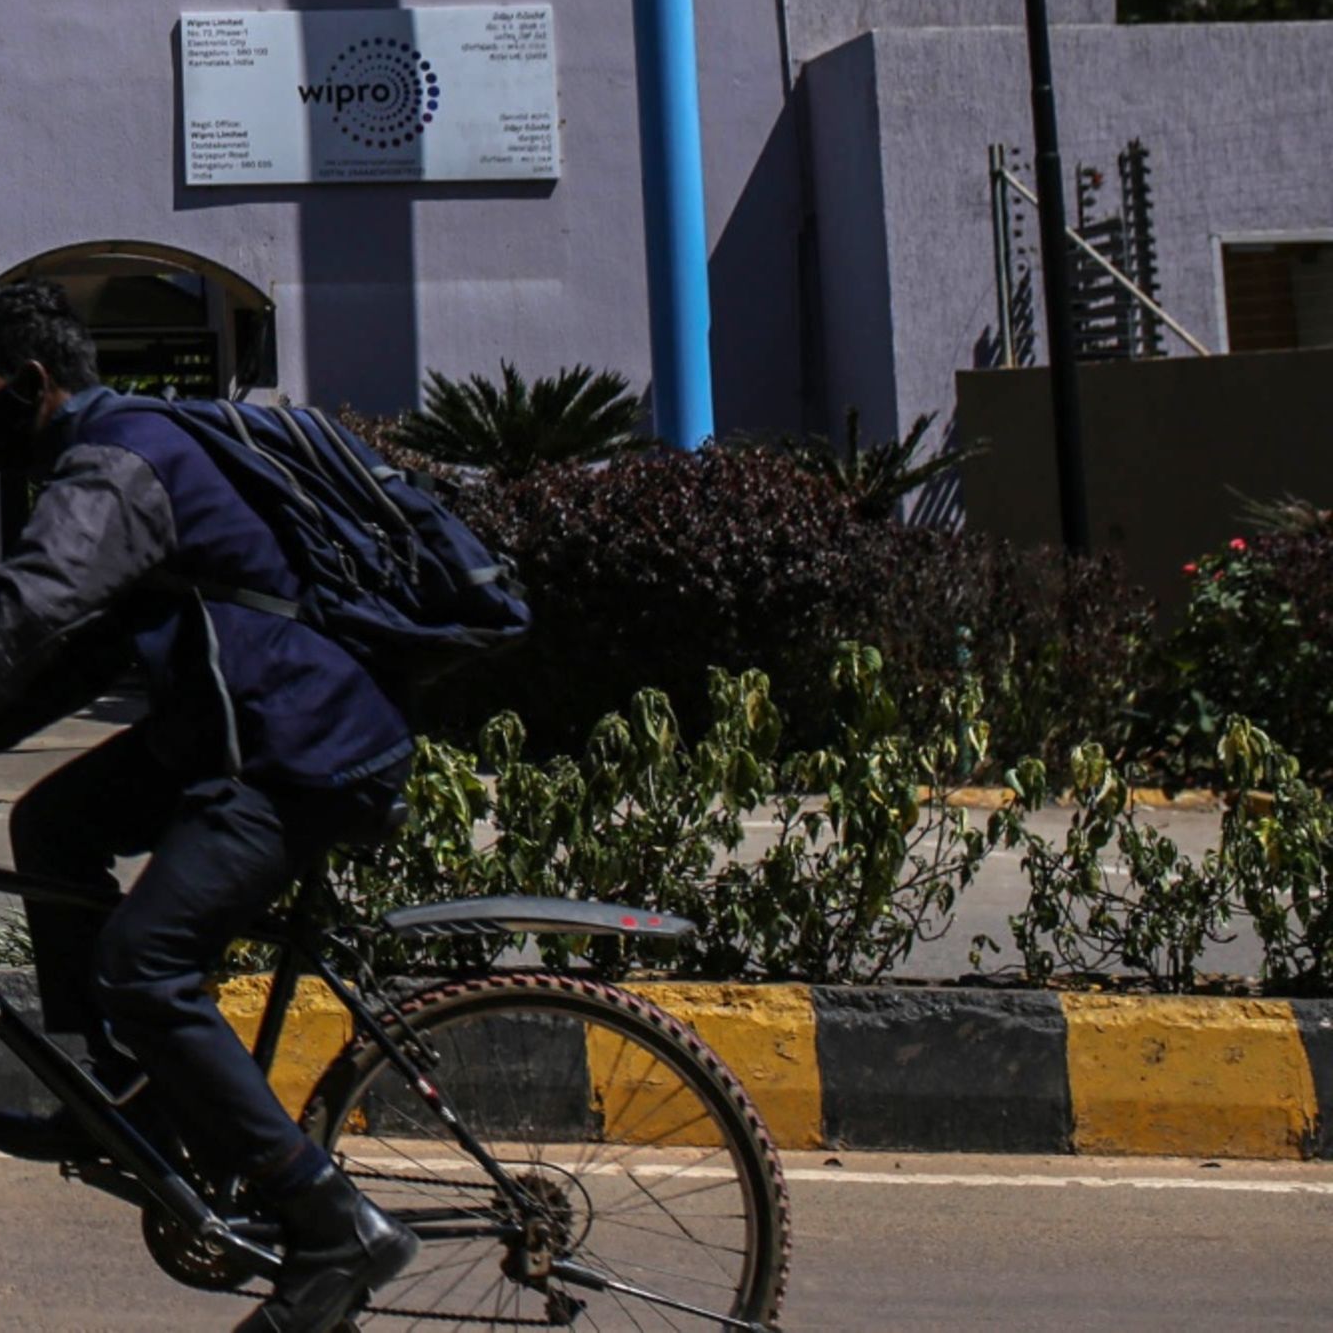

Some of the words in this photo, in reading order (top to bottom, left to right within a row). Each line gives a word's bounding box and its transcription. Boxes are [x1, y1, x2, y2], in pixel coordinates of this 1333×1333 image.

[187, 19, 210, 28] Wipro
[212, 18, 243, 26] Limited
[187, 39, 228, 47] Electronic
[230, 39, 246, 48] City
[298, 79, 390, 112] wipro
[191, 131, 214, 140] Wipro
[217, 130, 248, 138] Limited
[229, 151, 249, 159] Road
[192, 162, 233, 171] Bengaluru
